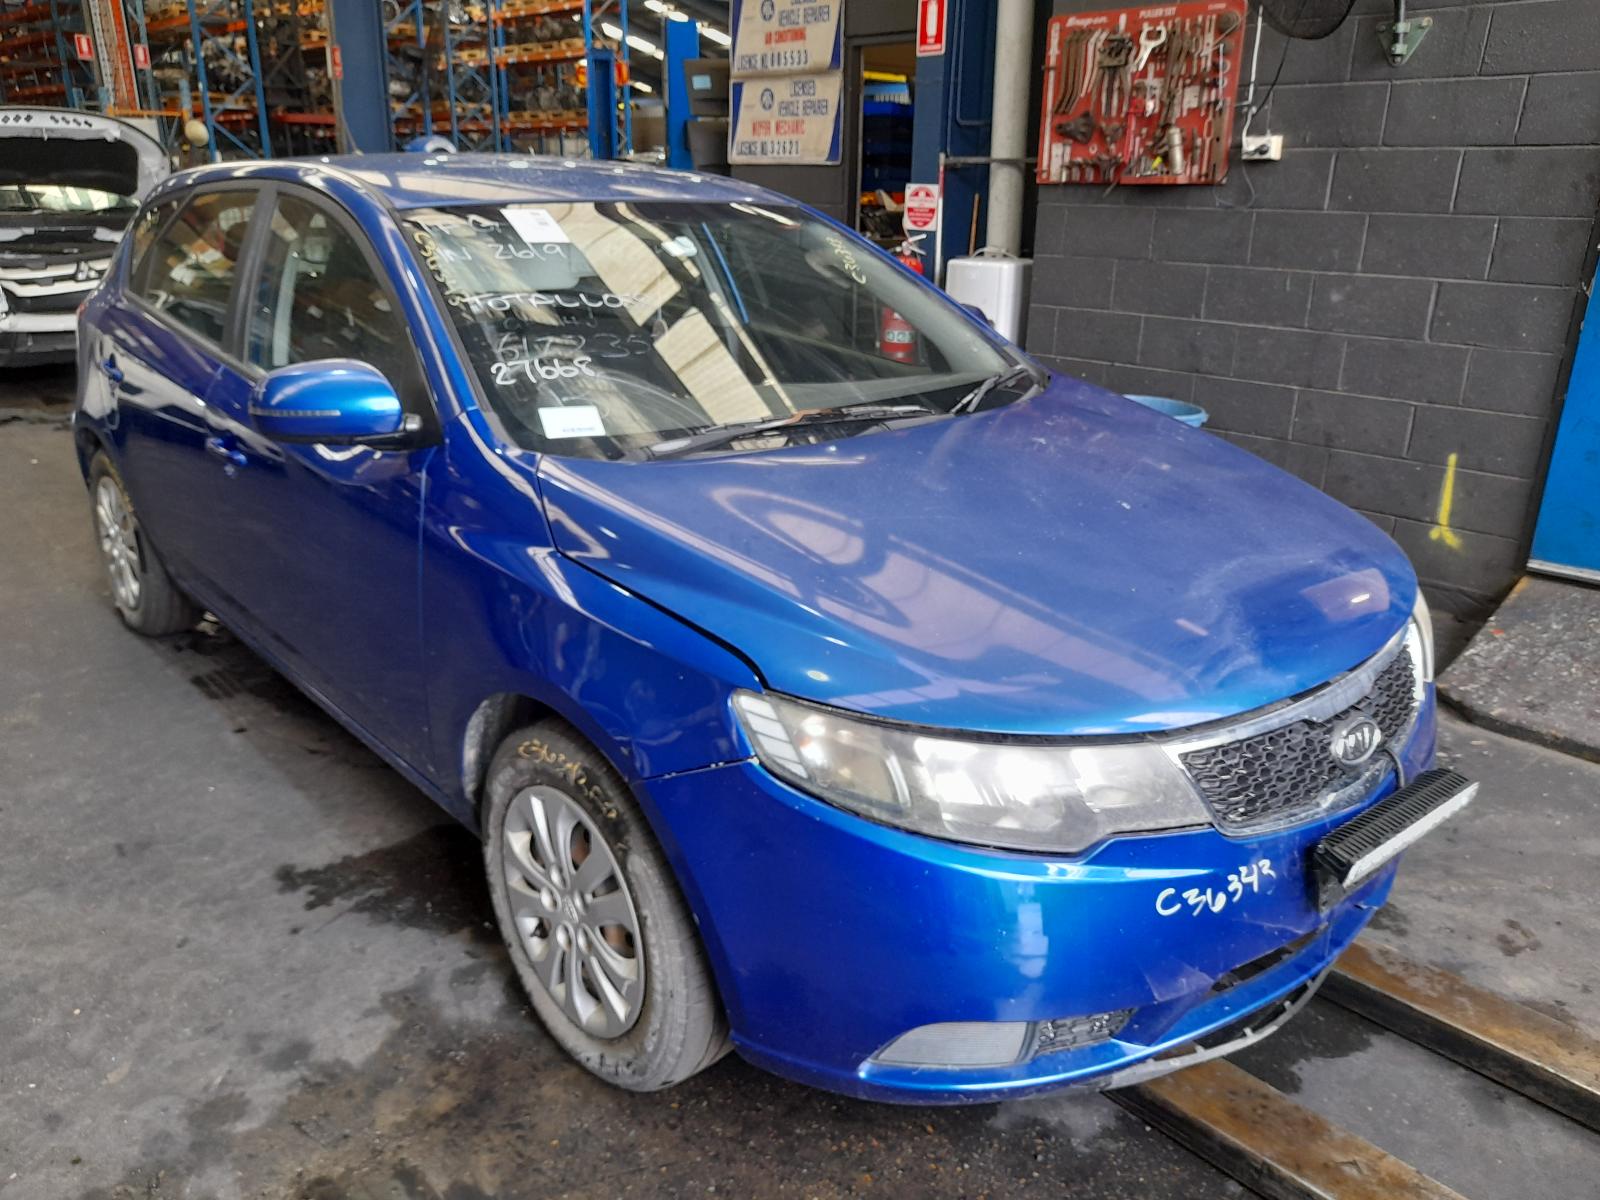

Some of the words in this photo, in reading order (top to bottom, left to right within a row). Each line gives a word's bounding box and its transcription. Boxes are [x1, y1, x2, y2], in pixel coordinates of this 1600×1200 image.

[779, 9, 800, 26] VEHICLE
[803, 5, 830, 24] REPAIRER
[779, 100, 800, 116] VEHICLE
[802, 99, 828, 116] REPAIRER
[490, 355, 597, 386] 27668
